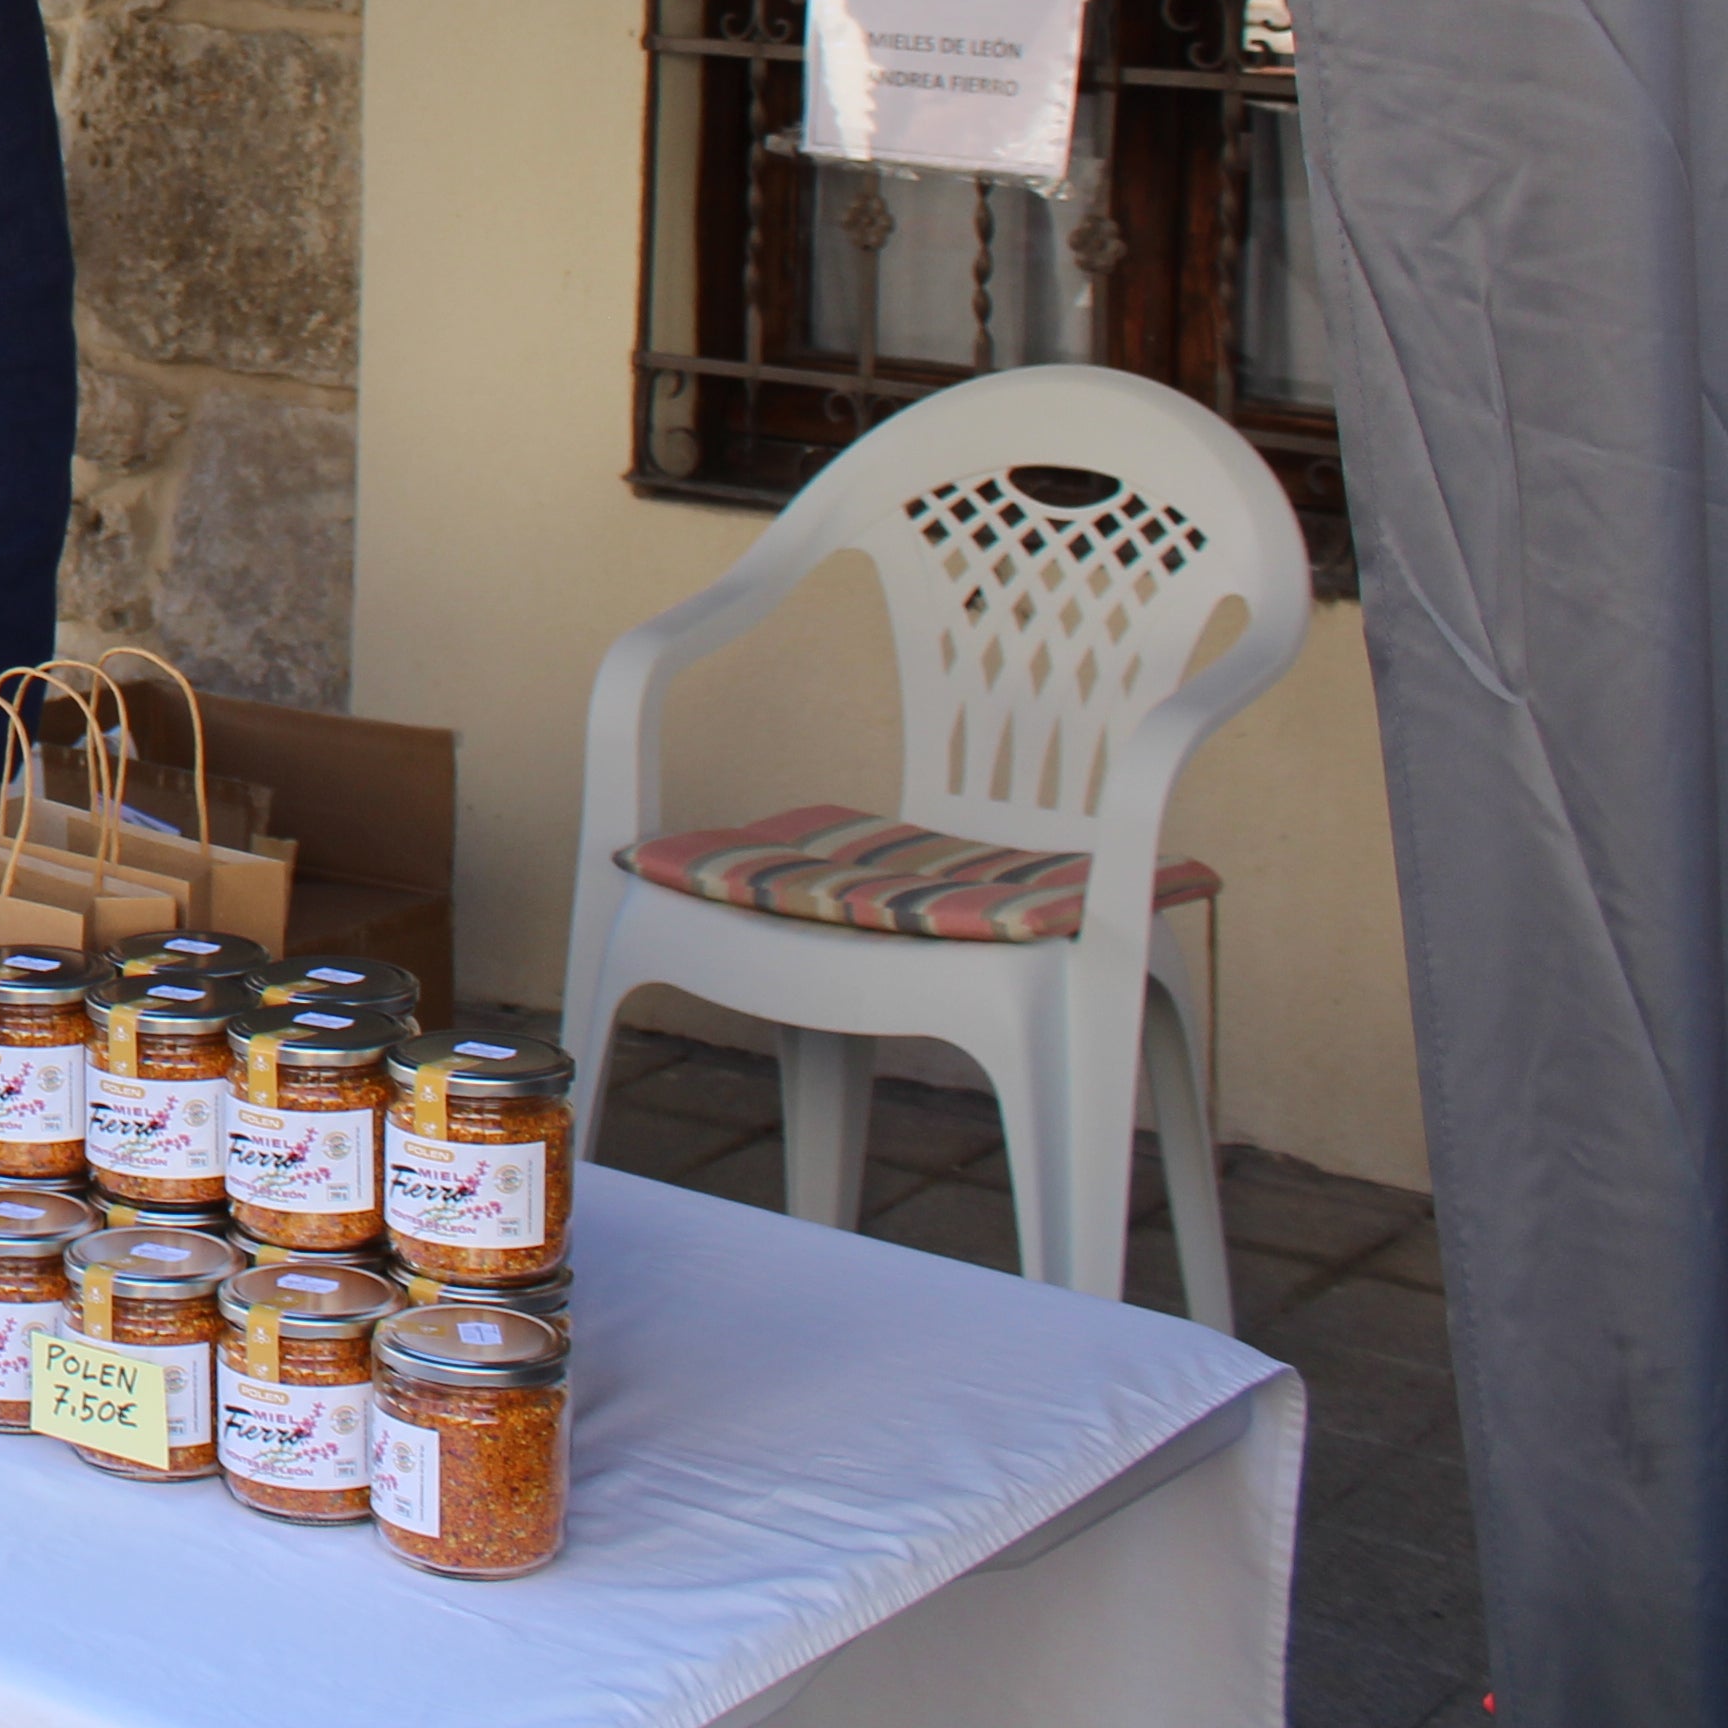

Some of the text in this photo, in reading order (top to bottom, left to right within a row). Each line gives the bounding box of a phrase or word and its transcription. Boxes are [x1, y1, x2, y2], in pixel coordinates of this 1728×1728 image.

[868, 32, 1022, 59] MIELES DE LEÓN
[950, 73, 1019, 97] FIERRO
[102, 1083, 143, 1098] POLEN
[88, 1102, 157, 1137] Fierro
[113, 1105, 152, 1117] MIEL
[241, 1112, 281, 1128] POLEN
[228, 1133, 297, 1169] Fierro
[252, 1136, 291, 1149] MIEL
[406, 1144, 452, 1161] POLEN
[390, 1164, 469, 1203] Fierro
[418, 1167, 461, 1182] MIEL
[47, 1343, 137, 1394] POLEN
[241, 1384, 286, 1404] POLEN
[54, 1384, 138, 1428] 7,50€
[254, 1409, 297, 1423] MIEL
[224, 1405, 303, 1446] Fierro
